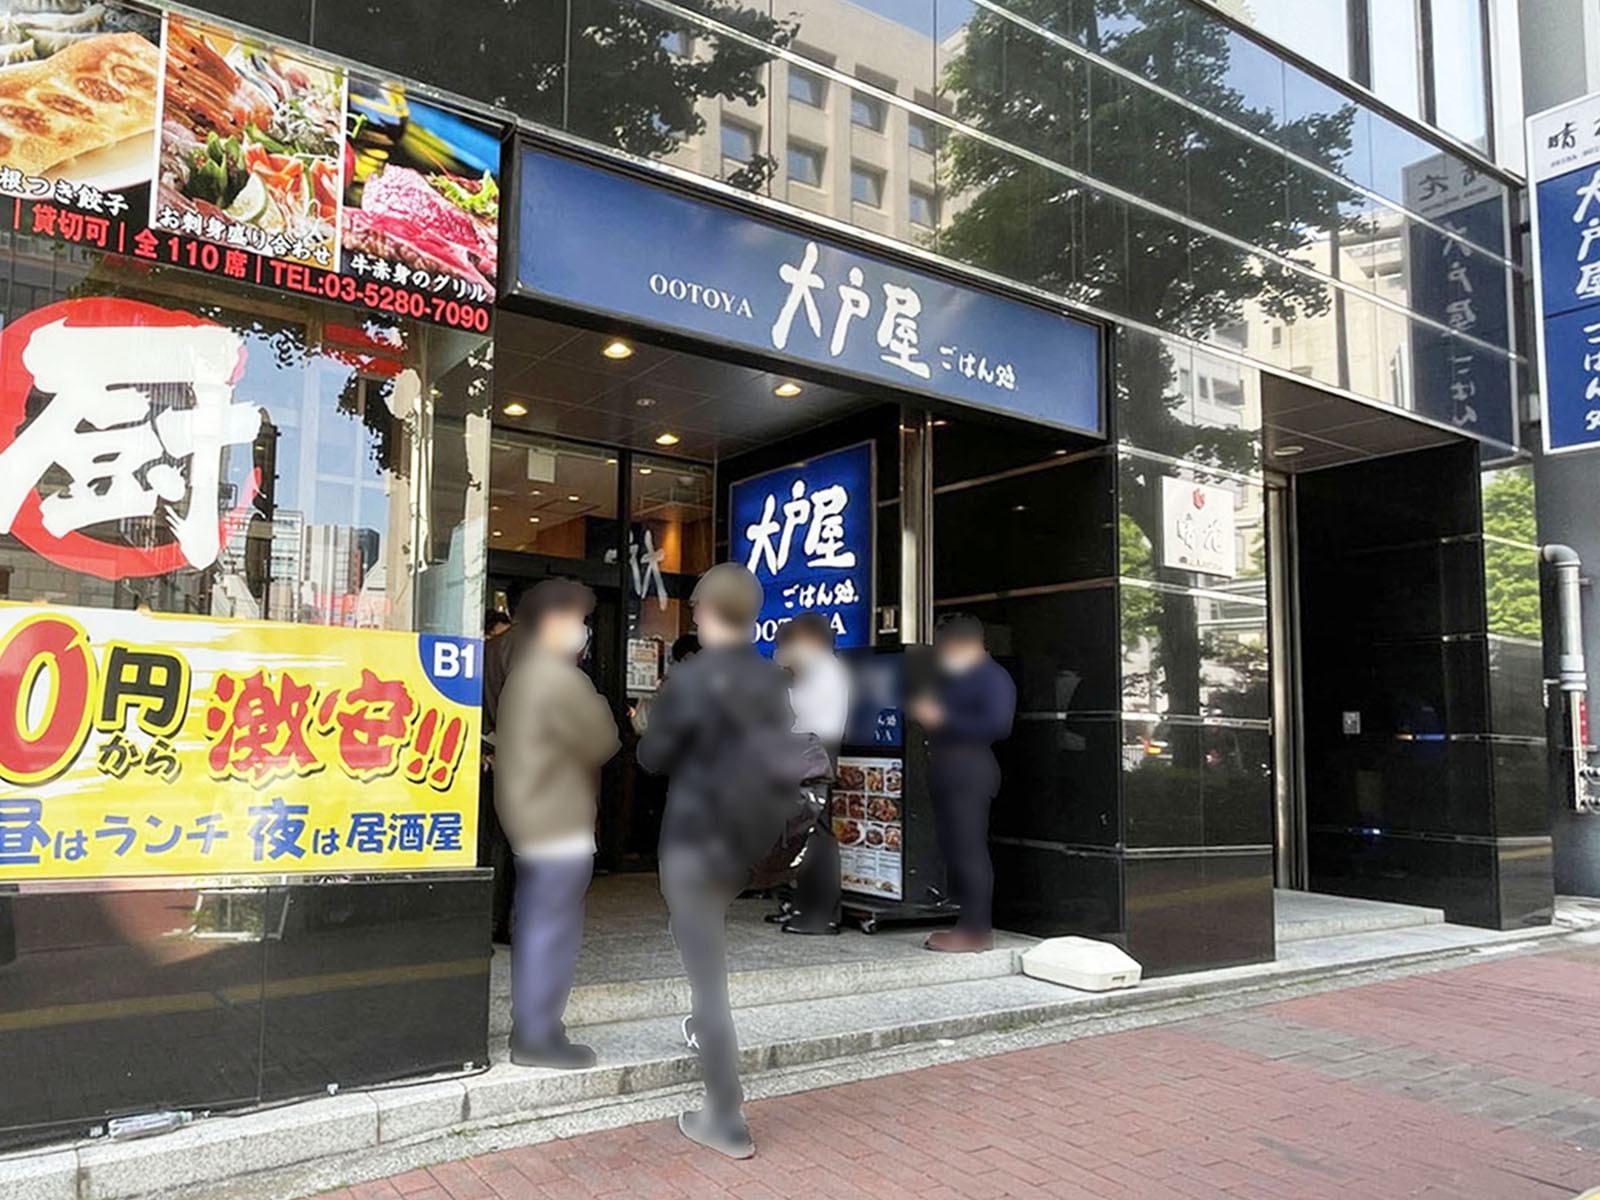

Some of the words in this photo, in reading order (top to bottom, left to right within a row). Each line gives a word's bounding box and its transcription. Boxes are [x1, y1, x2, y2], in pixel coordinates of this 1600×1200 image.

[32, 203, 110, 248] 貸切可
[159, 205, 333, 265] お刺身盛り合わせ
[351, 253, 488, 302] 牛赤身のグリル
[649, 274, 754, 320] OOTOYA
[771, 241, 931, 379] 大戸屋
[746, 480, 855, 576] 大戸屋
[434, 641, 475, 679] B1
[98, 735, 182, 781] から
